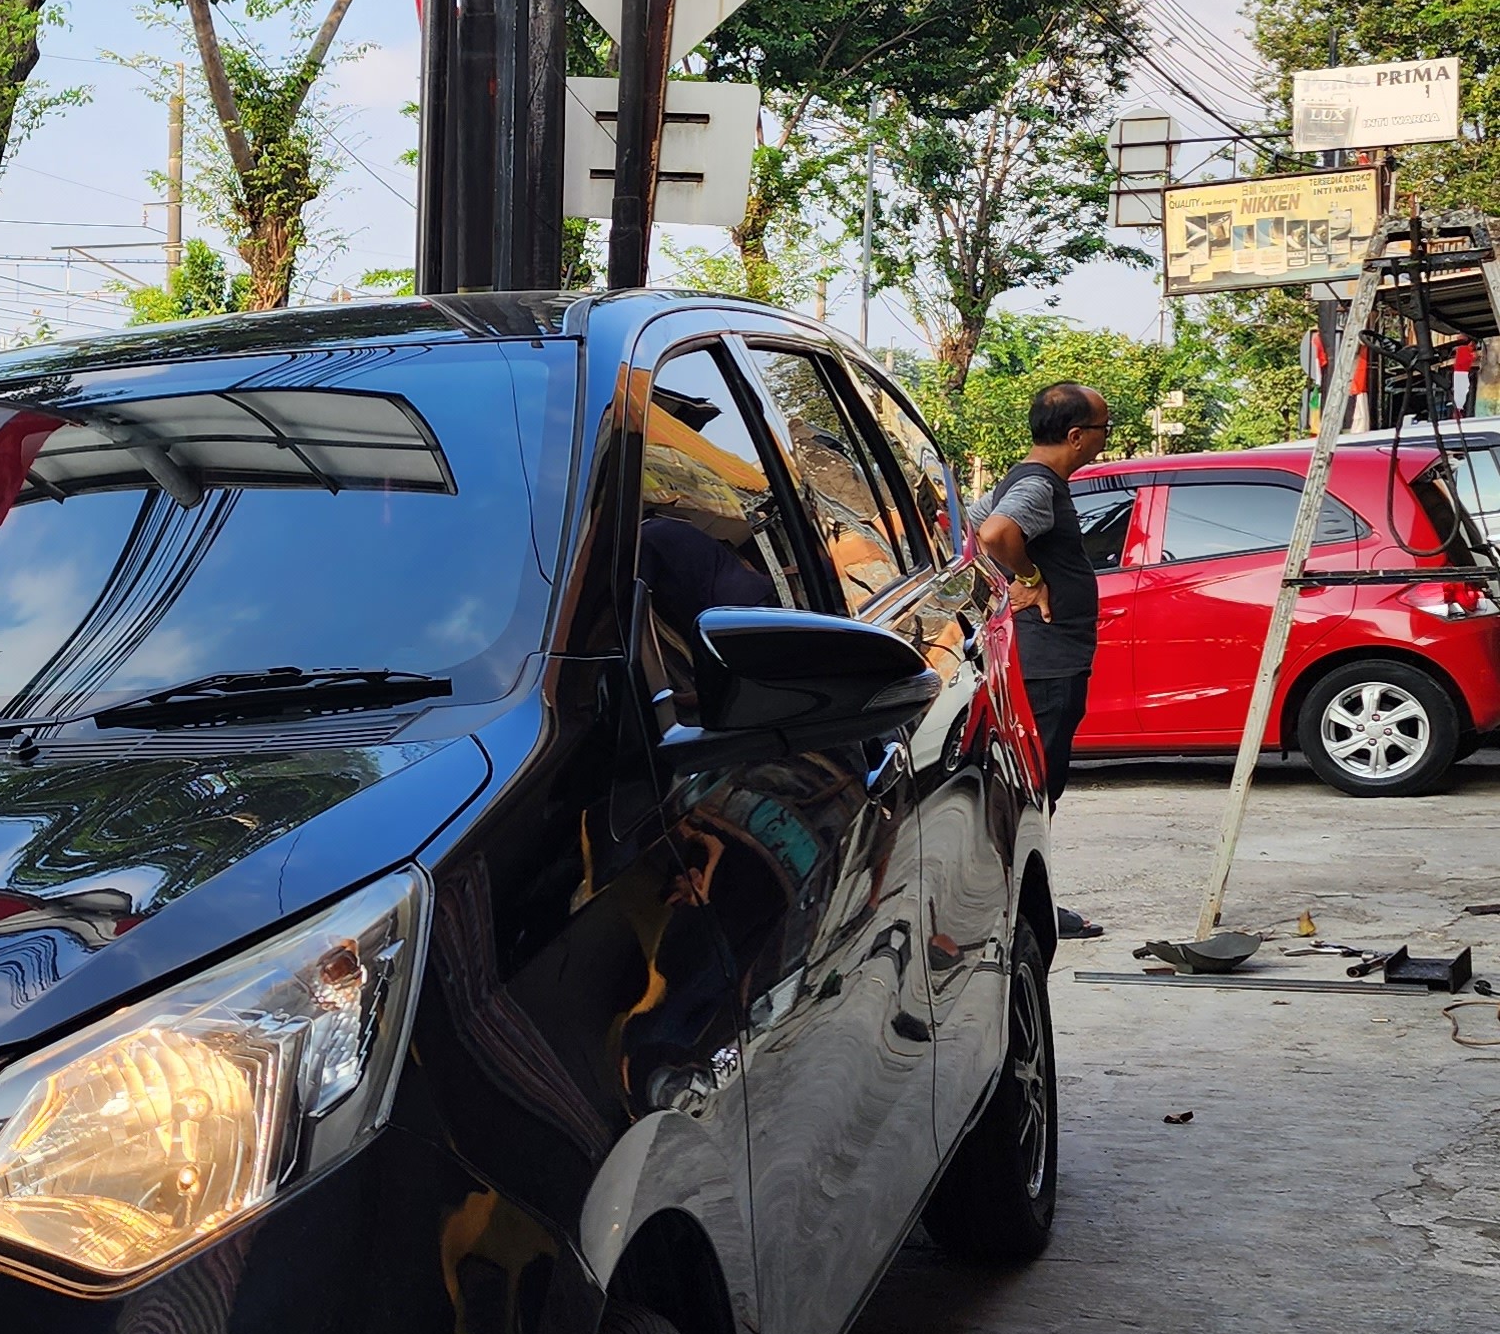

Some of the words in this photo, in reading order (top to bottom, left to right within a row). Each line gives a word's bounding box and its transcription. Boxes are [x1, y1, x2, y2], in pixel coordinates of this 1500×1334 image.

[1376, 65, 1451, 87] PRIMA
[1309, 107, 1348, 121] LUX
[1392, 113, 1441, 126] WARNA
[1259, 182, 1301, 195] AUTOMOTIVE
[1313, 186, 1332, 196] INTI
[1335, 183, 1368, 194] WARNA
[1168, 197, 1201, 210] QUALITY
[1240, 193, 1301, 215] NIKKEN
